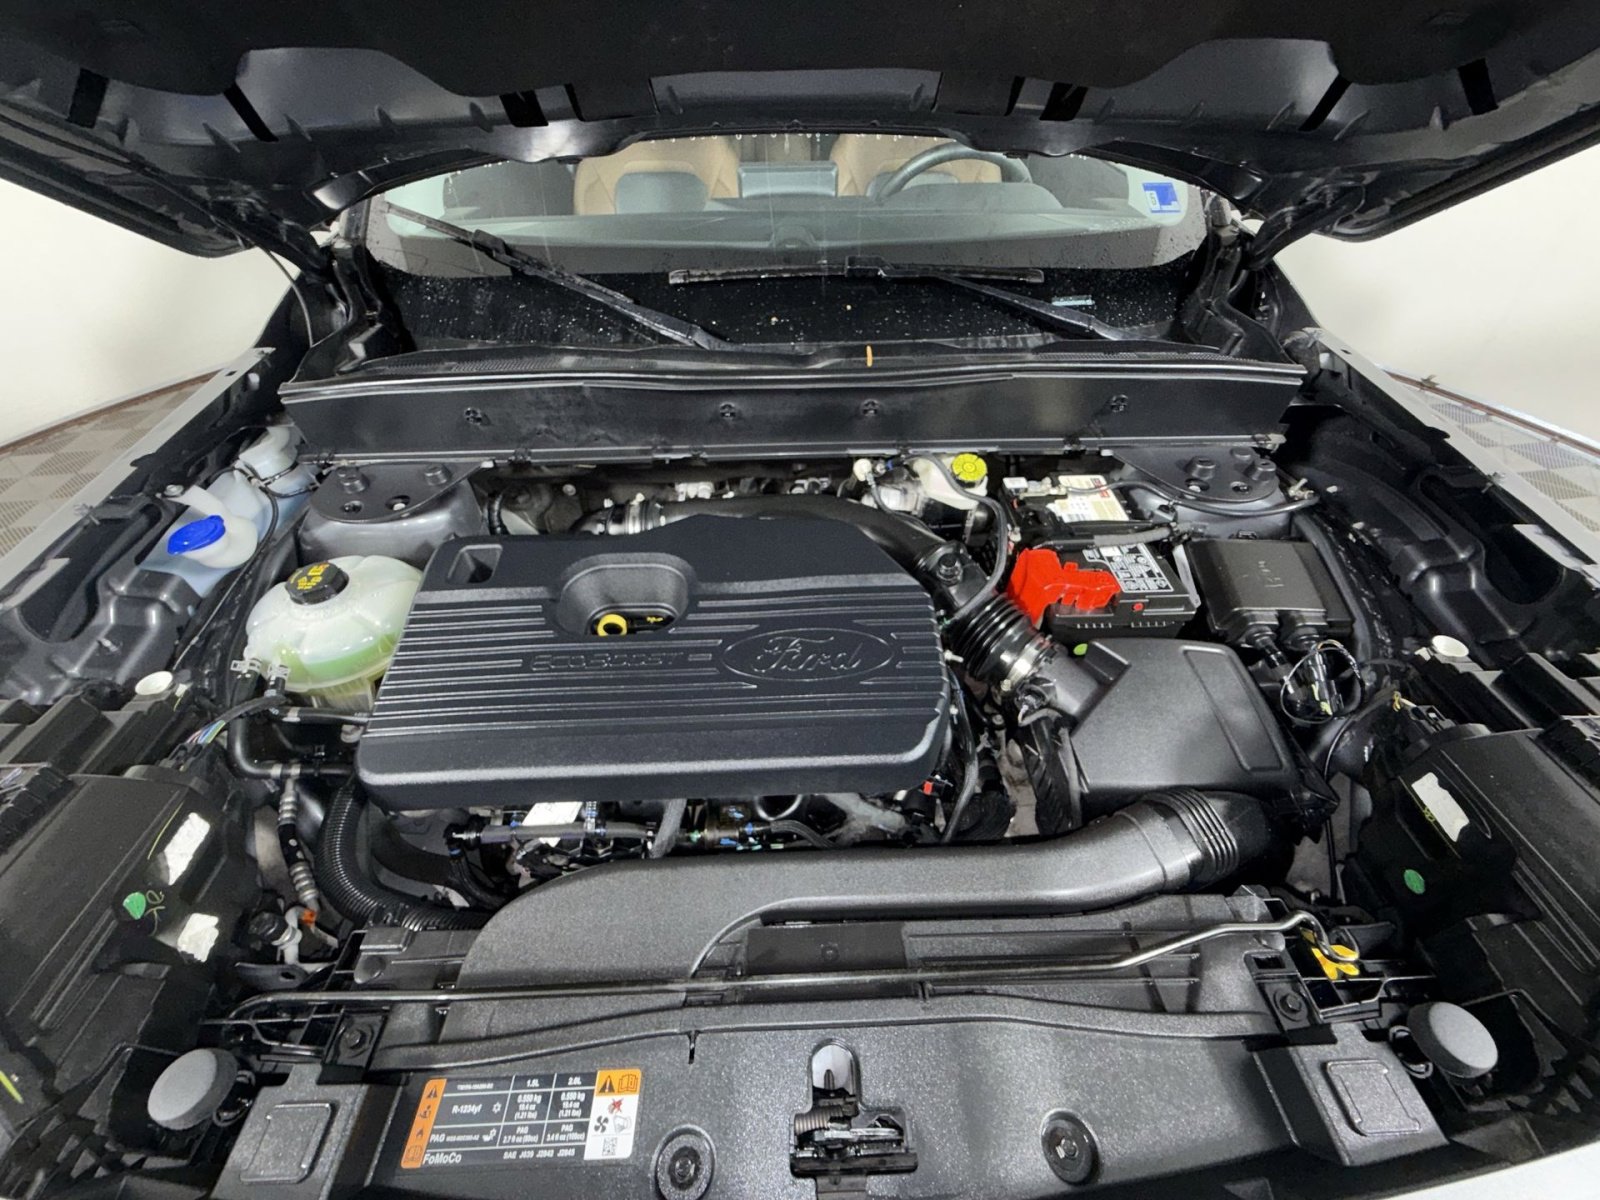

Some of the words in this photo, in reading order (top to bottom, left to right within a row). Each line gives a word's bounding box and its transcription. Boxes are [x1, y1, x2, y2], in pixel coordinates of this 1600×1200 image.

[751, 636, 865, 674] Ford
[451, 1104, 482, 1115] R-1234yf
[429, 1133, 446, 1143] PAG
[423, 1152, 462, 1165] FoMoCo
